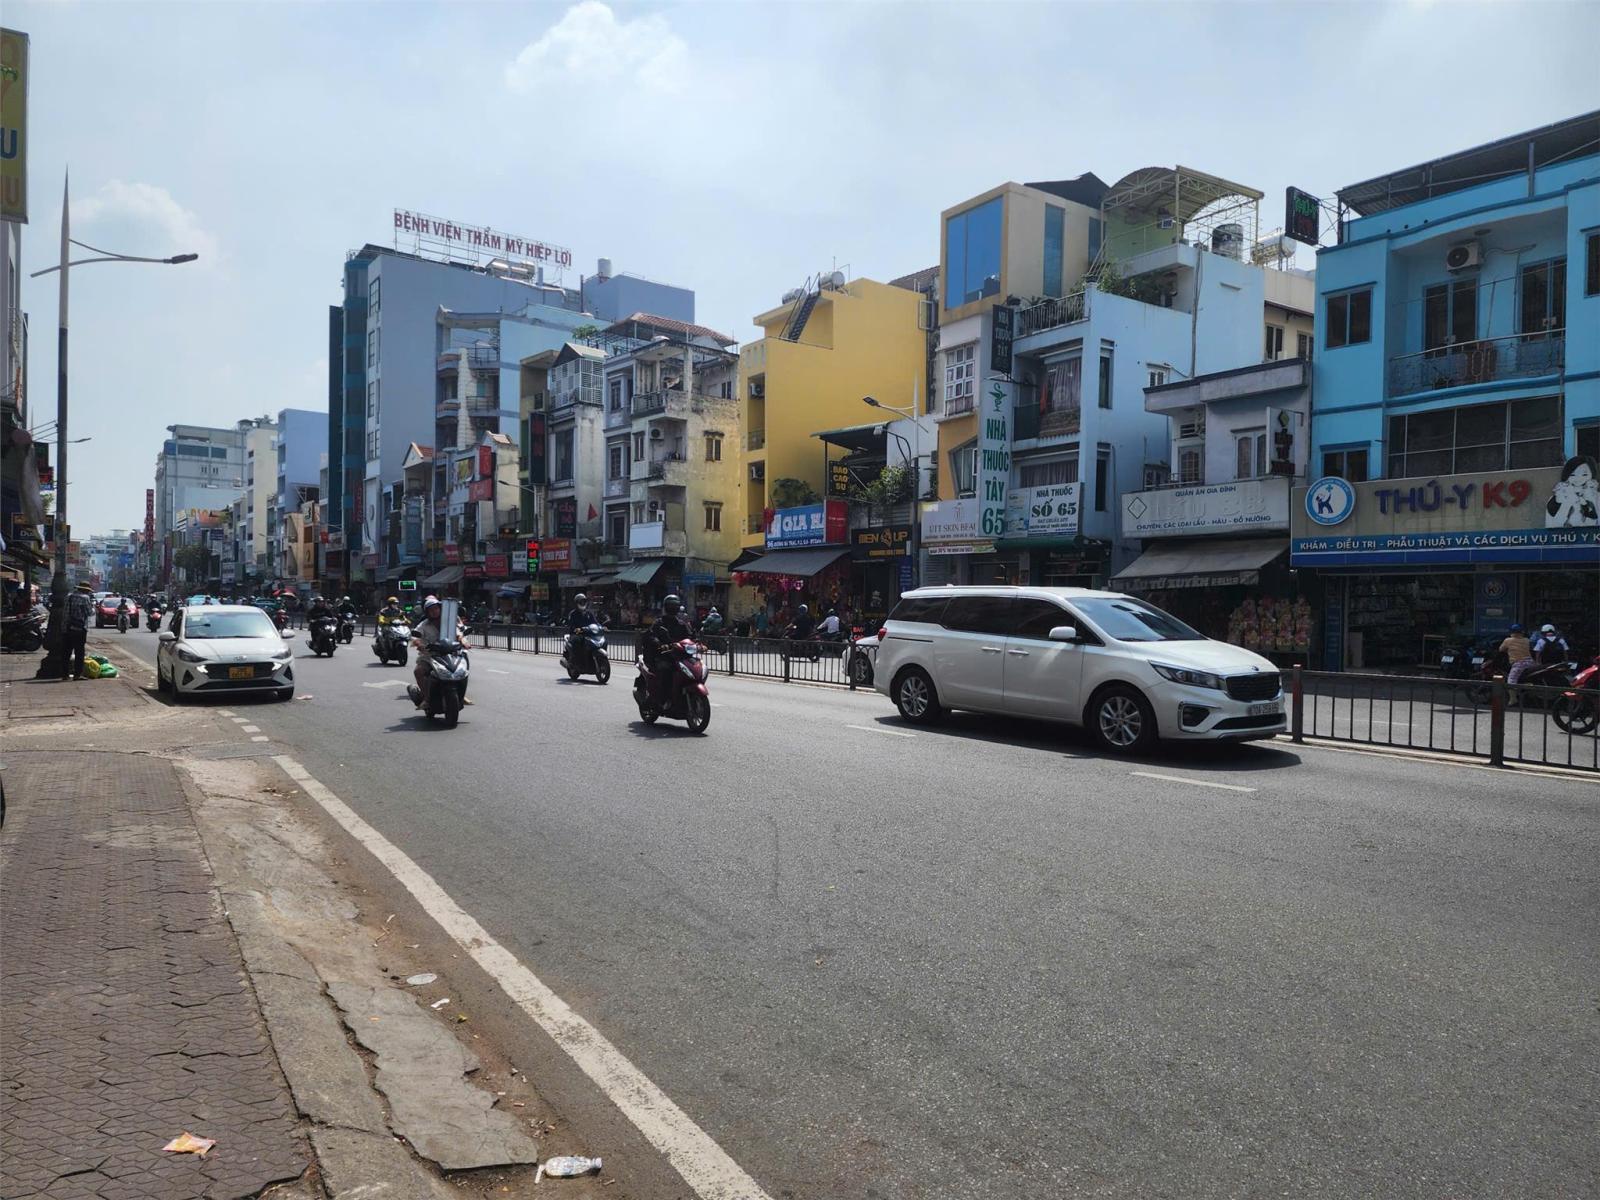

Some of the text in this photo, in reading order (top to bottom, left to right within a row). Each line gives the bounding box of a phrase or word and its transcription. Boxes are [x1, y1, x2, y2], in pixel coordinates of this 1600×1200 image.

[394, 211, 430, 233] BỆNH
[433, 220, 462, 242] VIỆN
[466, 226, 501, 250] THẨM
[506, 239, 523, 255] MỸ
[986, 415, 1006, 441] NHÀ
[983, 444, 1009, 472] THUỐC
[985, 476, 1004, 502] TÂY
[1036, 485, 1073, 498] NHÀ THUỐC
[1483, 480, 1531, 509] K9
[982, 507, 1005, 535] 65
[1032, 498, 1076, 518] SỐ 65
[893, 529, 909, 542] UP
[1299, 539, 1327, 550] KHÁM
[1362, 540, 1376, 550] TRỊ
[1387, 536, 1415, 548] PHẪU
[1417, 536, 1452, 549] THUẬT
[1455, 535, 1470, 545] VÀ
[1474, 535, 1497, 545] CÁC
[1500, 535, 1527, 546] DỊCH
[1531, 535, 1547, 545] VỤ
[1552, 531, 1577, 543] THÚ
[1581, 532, 1589, 542] Y
